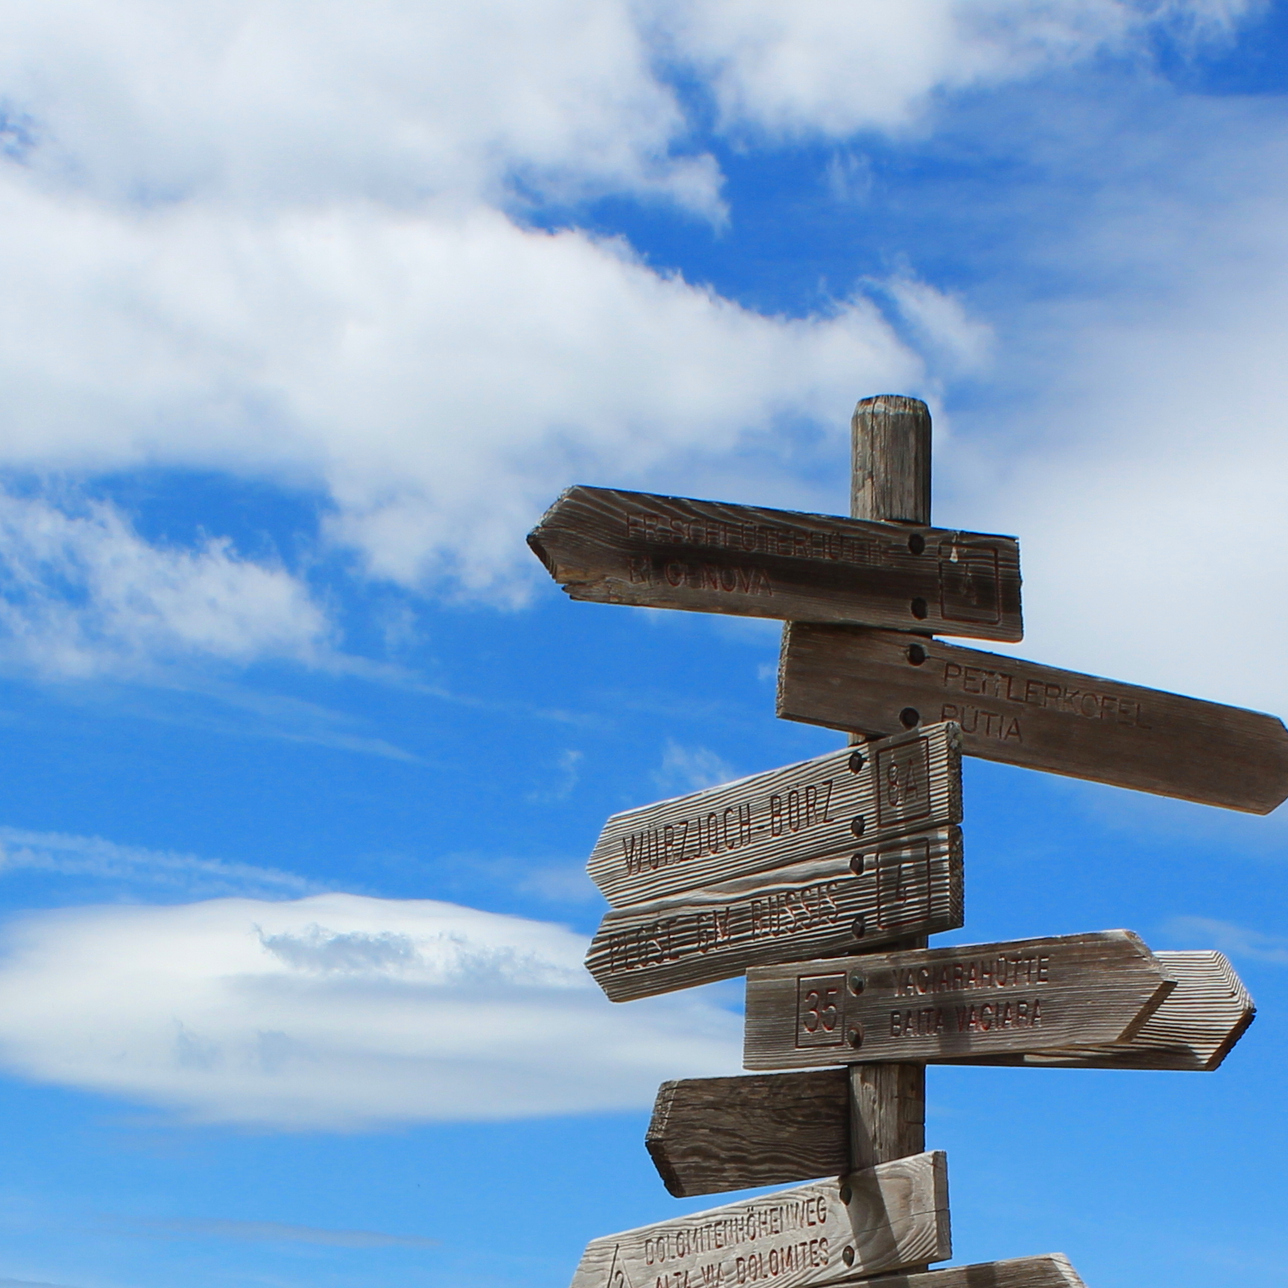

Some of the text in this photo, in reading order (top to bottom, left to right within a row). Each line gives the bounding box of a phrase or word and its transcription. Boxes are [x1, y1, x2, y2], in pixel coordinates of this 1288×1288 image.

[943, 661, 1152, 730] PEITLERKOFEL
[941, 702, 1023, 744] PÜTIA
[886, 756, 922, 807] 8A
[803, 988, 838, 1033] 35
[890, 998, 1042, 1037] BAITA VACIARA
[736, 1237, 830, 1285] DOLOMITES
